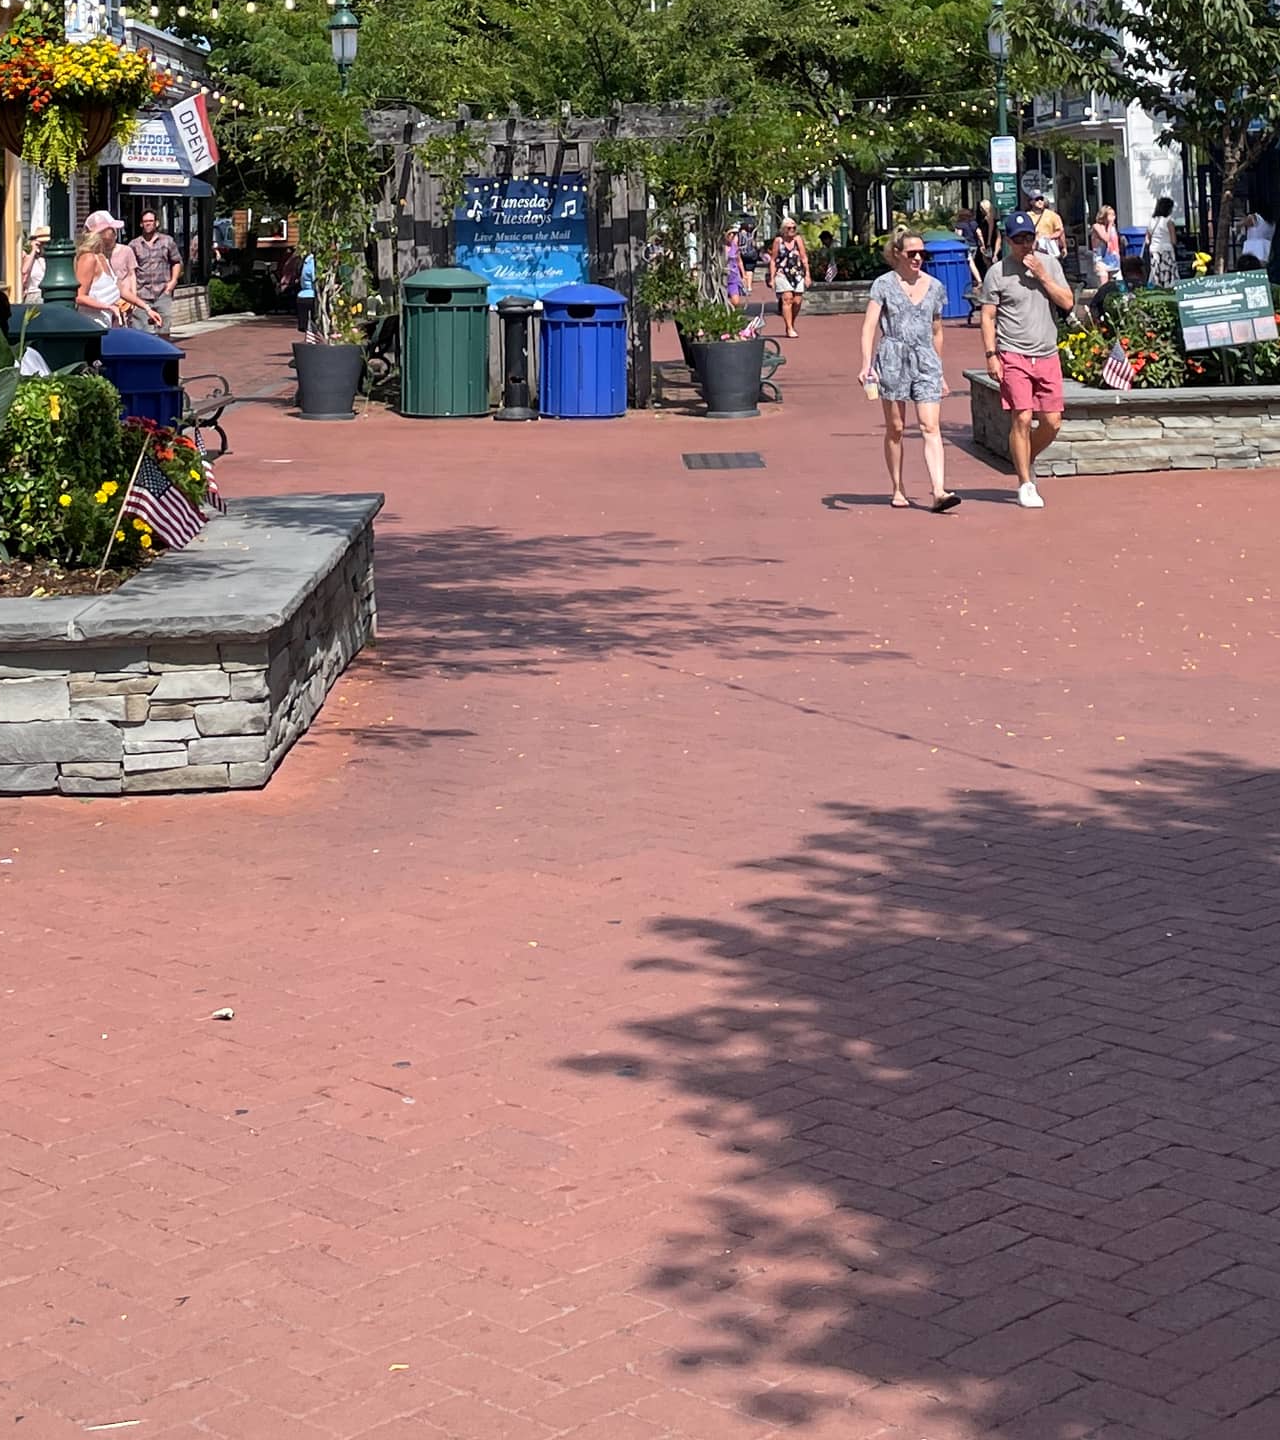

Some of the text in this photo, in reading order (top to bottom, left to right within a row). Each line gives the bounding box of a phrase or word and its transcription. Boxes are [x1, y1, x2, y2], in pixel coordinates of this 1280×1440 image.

[179, 110, 208, 163] OPEN
[127, 145, 175, 156] KITCHE
[490, 194, 553, 211] Tunesday
[493, 210, 552, 227] Tuesdays
[474, 232, 493, 242] Live
[495, 232, 519, 242] Music
[535, 231, 548, 241] the
